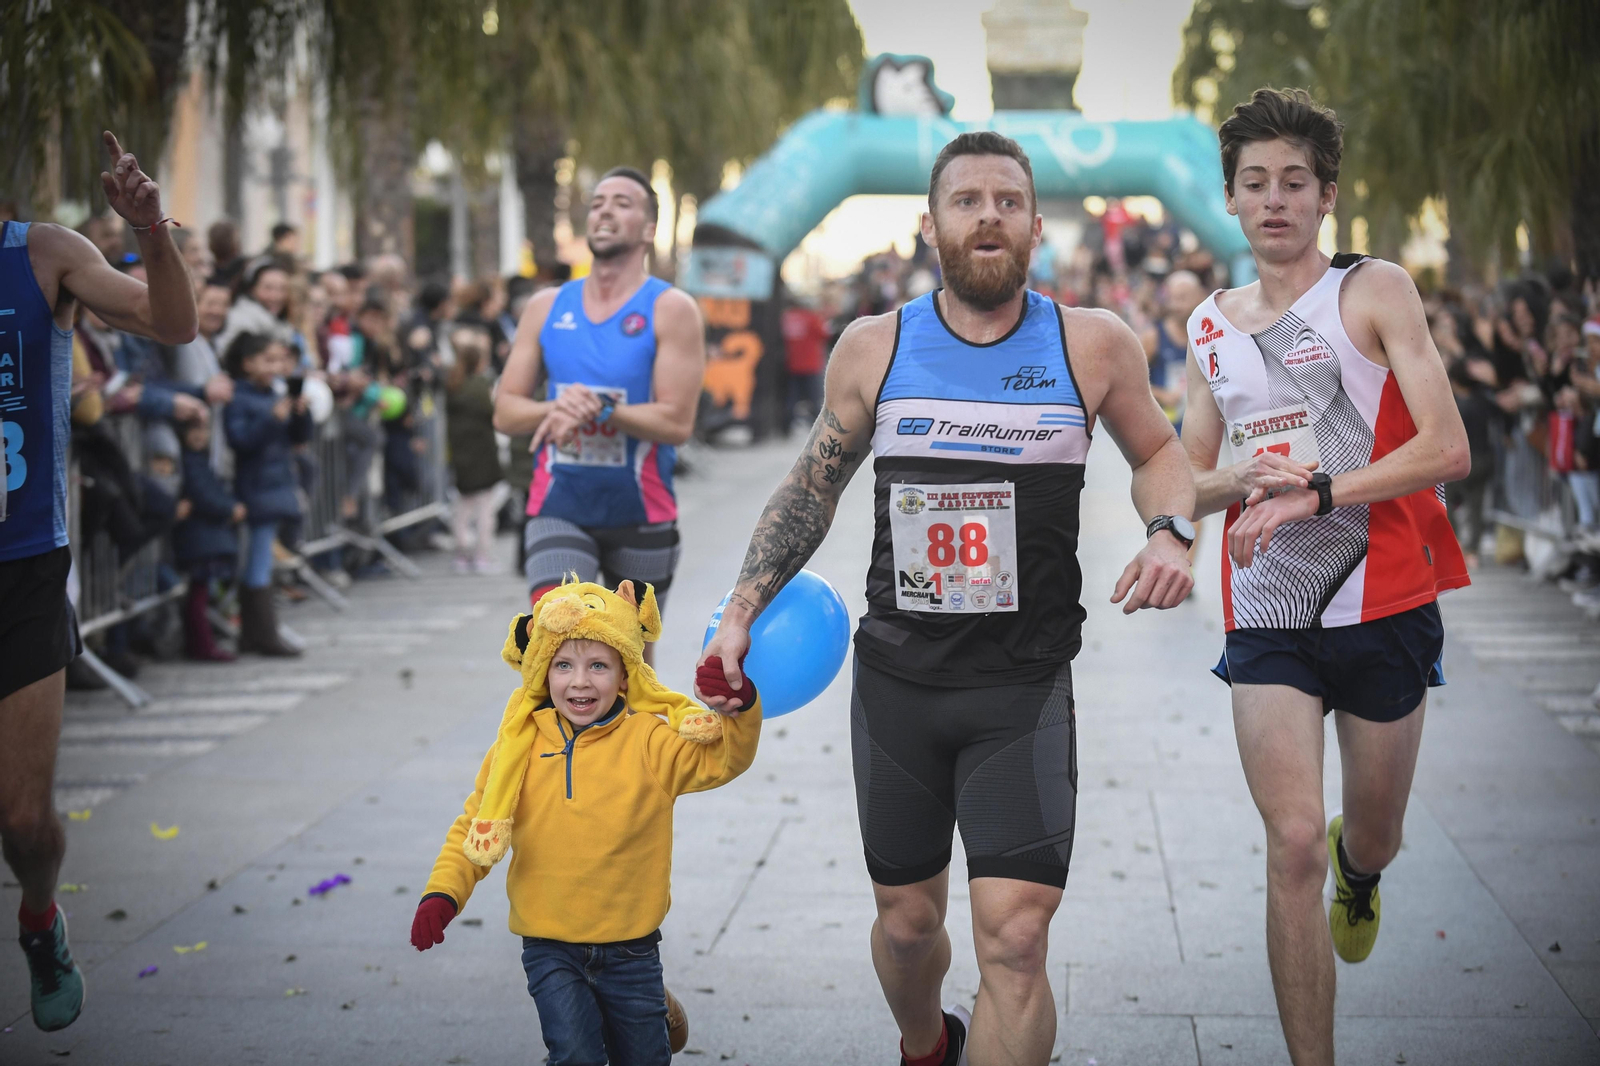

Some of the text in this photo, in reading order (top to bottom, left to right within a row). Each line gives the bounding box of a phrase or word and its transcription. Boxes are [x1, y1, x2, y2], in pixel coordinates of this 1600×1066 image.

[1195, 329, 1224, 346] VIATOR
[1001, 374, 1056, 391] Team
[1253, 419, 1267, 428] SAN
[1268, 410, 1308, 424] SILVESTRE
[936, 420, 1063, 441] TrailRunner
[981, 445, 1016, 455] STORE
[938, 499, 1003, 508] GADITANA
[941, 492, 959, 500] SAN
[961, 491, 1012, 500] SILVESTRE
[927, 522, 989, 567] 88
